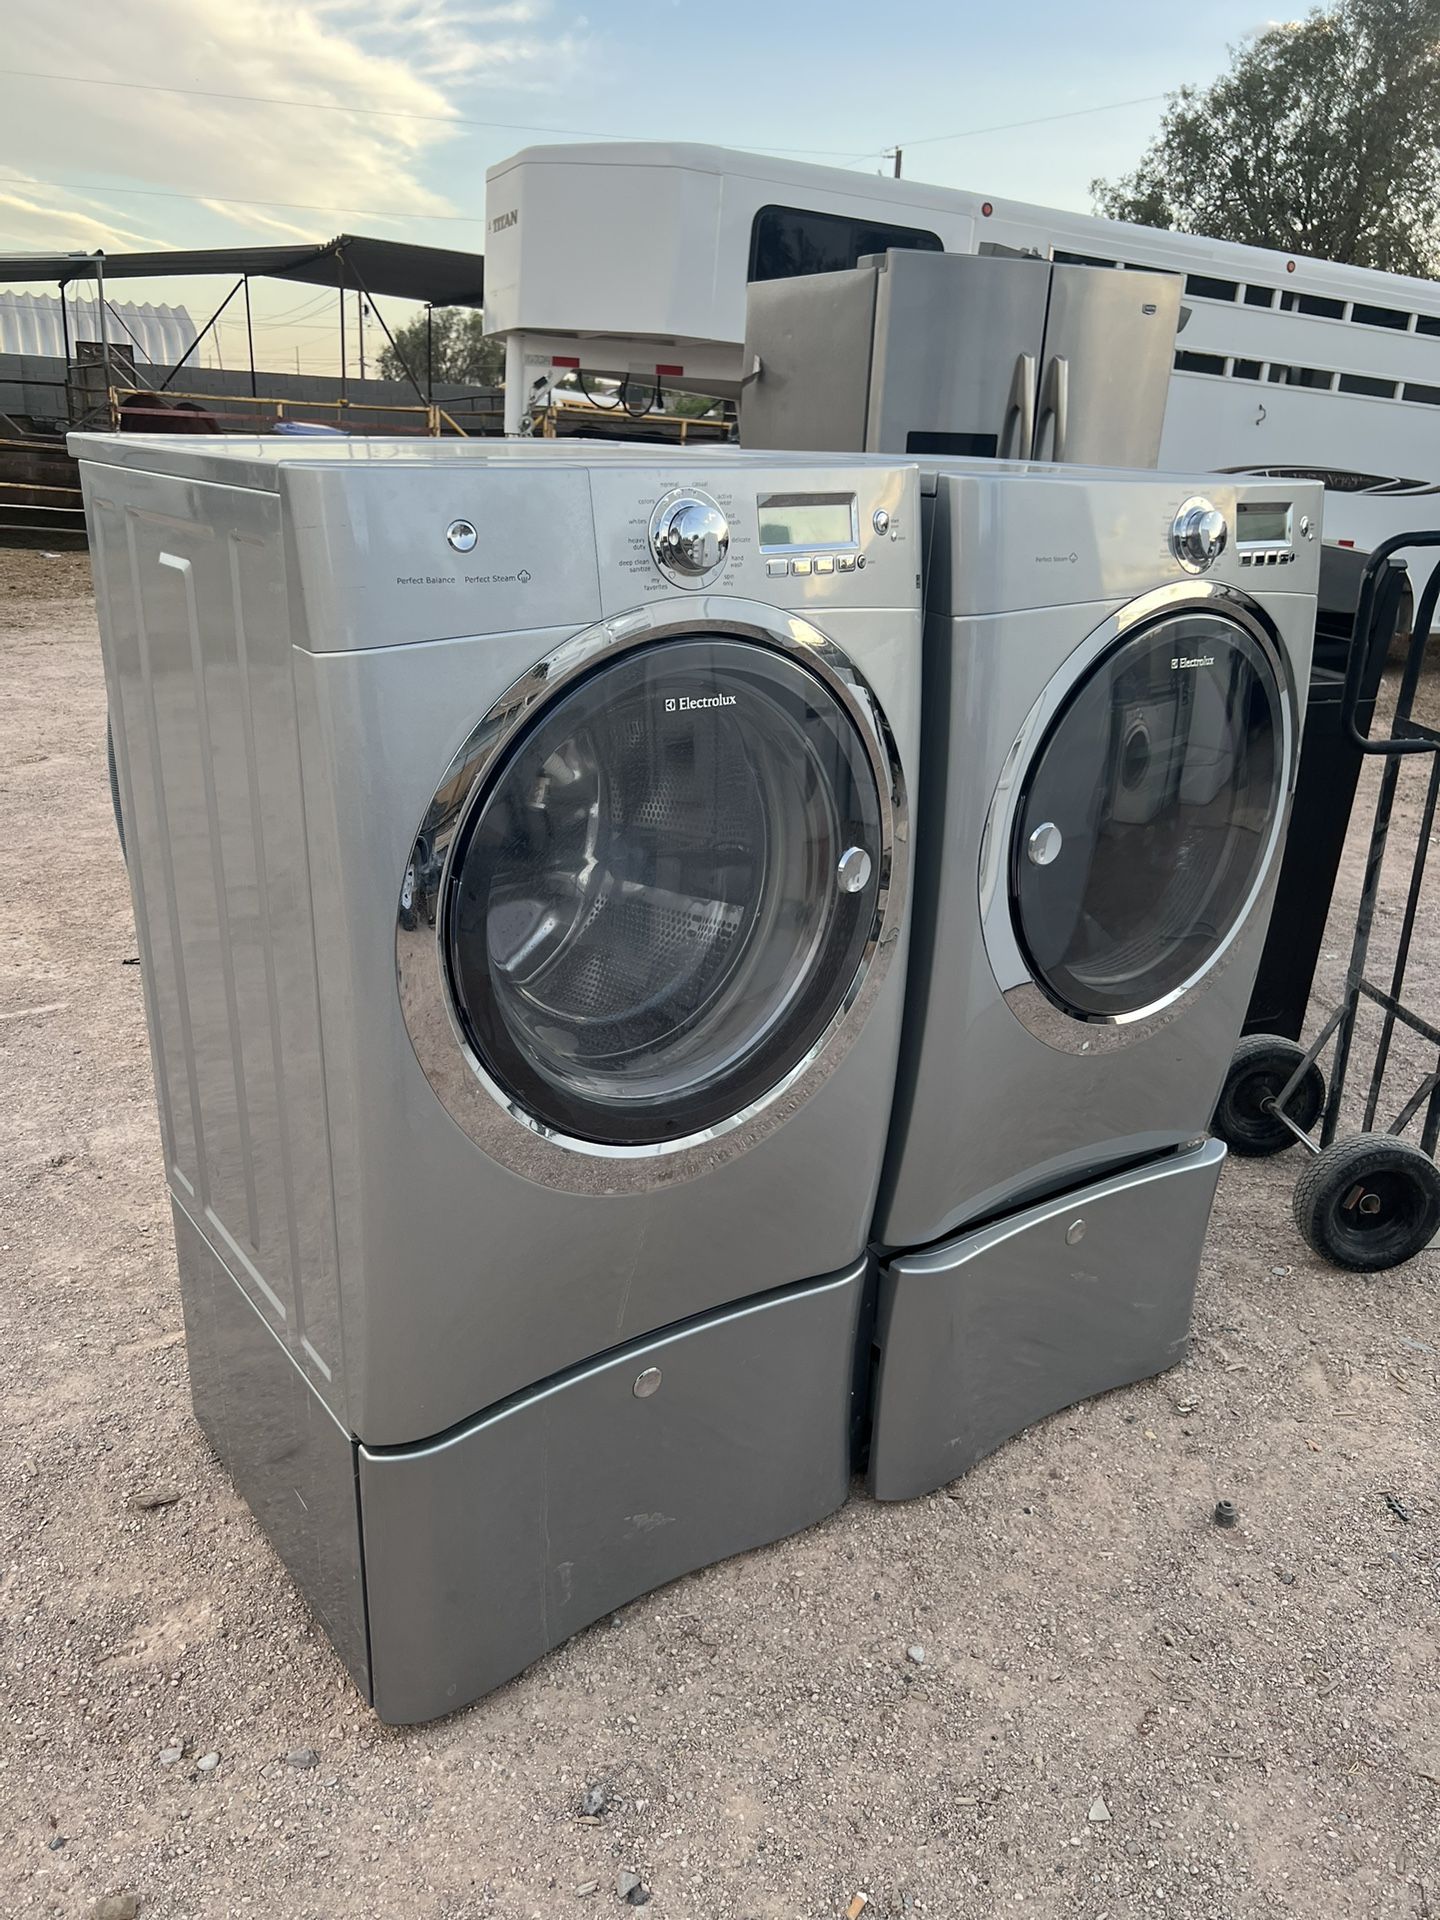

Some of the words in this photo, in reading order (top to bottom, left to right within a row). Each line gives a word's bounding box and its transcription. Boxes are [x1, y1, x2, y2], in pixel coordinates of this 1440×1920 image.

[493, 209, 518, 233] TITAN
[397, 576, 424, 585] Perfect
[426, 576, 456, 585] Balance
[464, 575, 490, 584] Perfect
[492, 574, 516, 583] Steam
[1179, 655, 1215, 669] Electrolux
[679, 693, 737, 711] Electrolux
